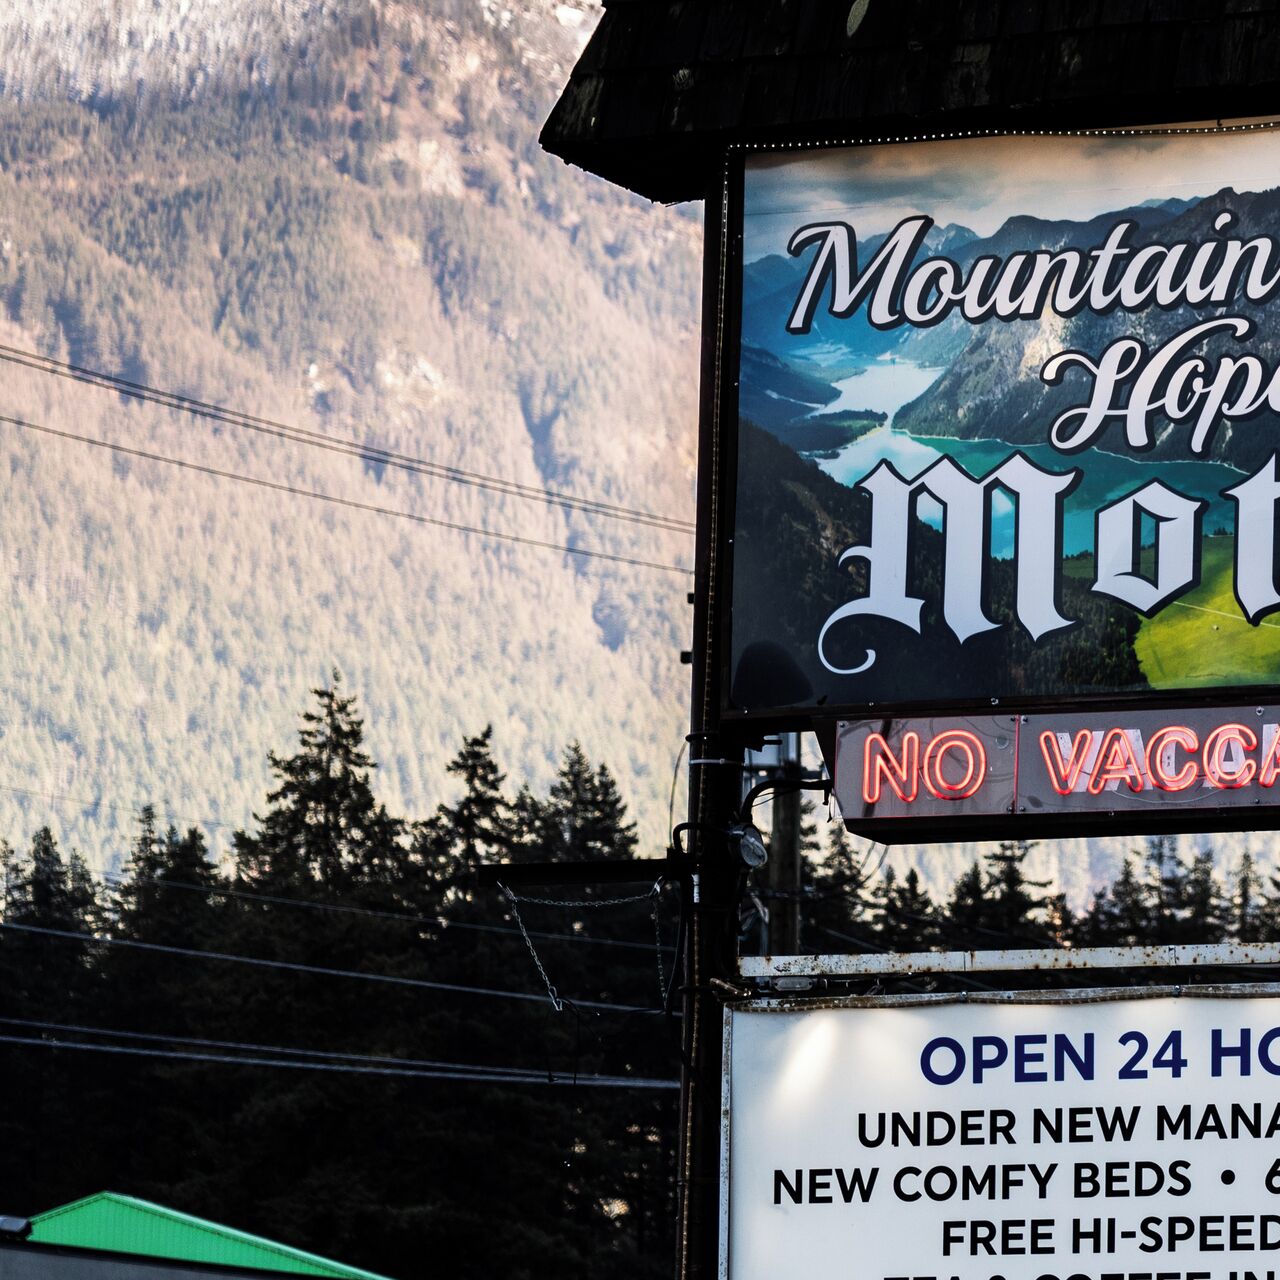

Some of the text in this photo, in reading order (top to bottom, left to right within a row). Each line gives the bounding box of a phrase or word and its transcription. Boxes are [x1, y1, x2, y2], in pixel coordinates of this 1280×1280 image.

[863, 729, 987, 803] NO
[920, 1032, 1095, 1086] OPEN
[1118, 1030, 1188, 1080] 24
[858, 1109, 1017, 1149] UNDER
[1033, 1105, 1142, 1144] NEW
[773, 1167, 880, 1205] NEW
[893, 1163, 1059, 1203] COMFY
[1073, 1159, 1192, 1199] BEDS
[942, 1218, 1056, 1257] FREE
